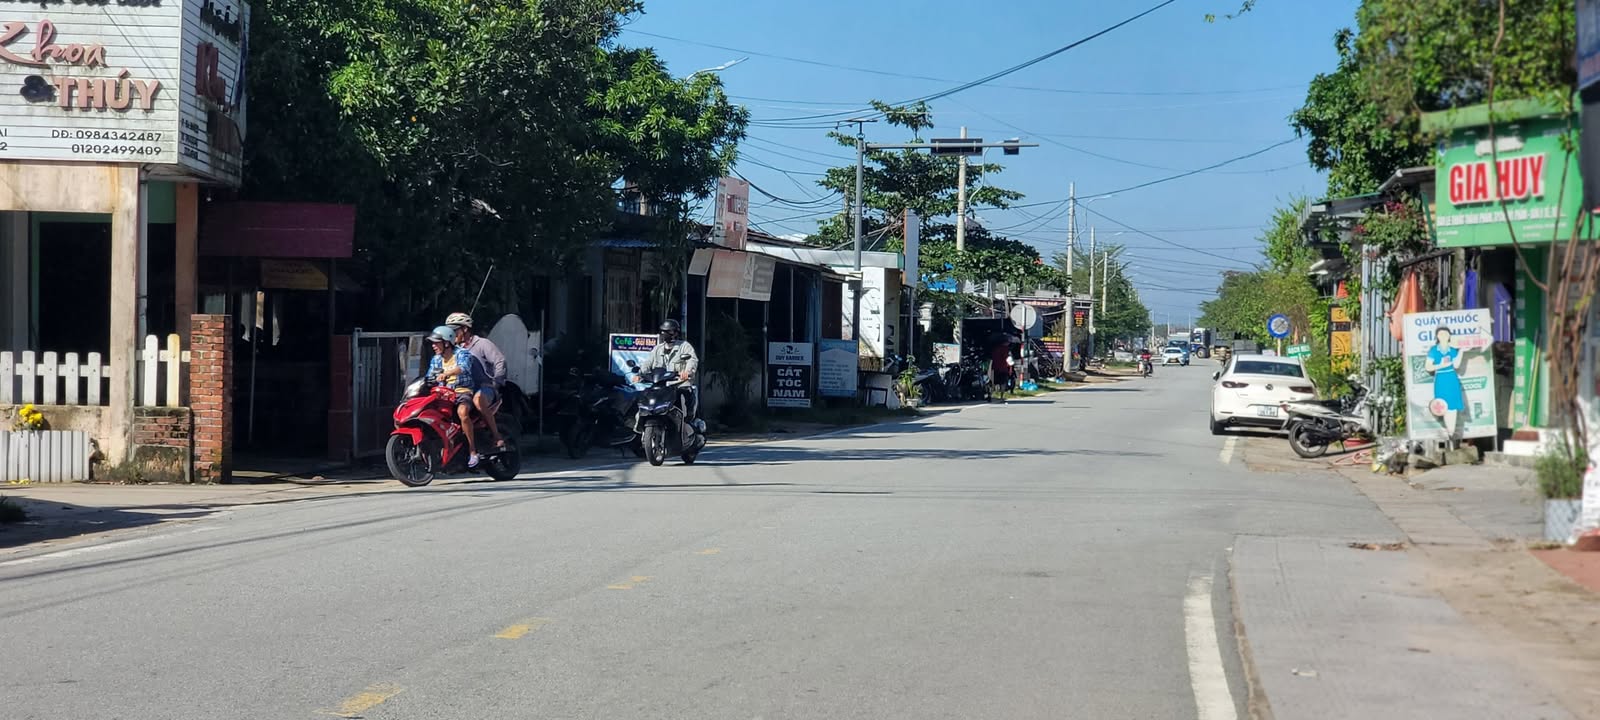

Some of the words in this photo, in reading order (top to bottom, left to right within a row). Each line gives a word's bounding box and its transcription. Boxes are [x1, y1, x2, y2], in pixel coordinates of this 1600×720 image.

[55, 68, 160, 109] THÚY
[52, 129, 73, 139] DĐ:
[76, 130, 162, 141] 0984342487
[72, 144, 162, 155] 01202499409
[1450, 162, 1489, 203] GIA
[1495, 155, 1543, 198] HUY
[614, 337, 632, 345] Café
[777, 366, 802, 376] CẮT
[777, 378, 802, 387] TÓC
[773, 389, 805, 398] NAM
